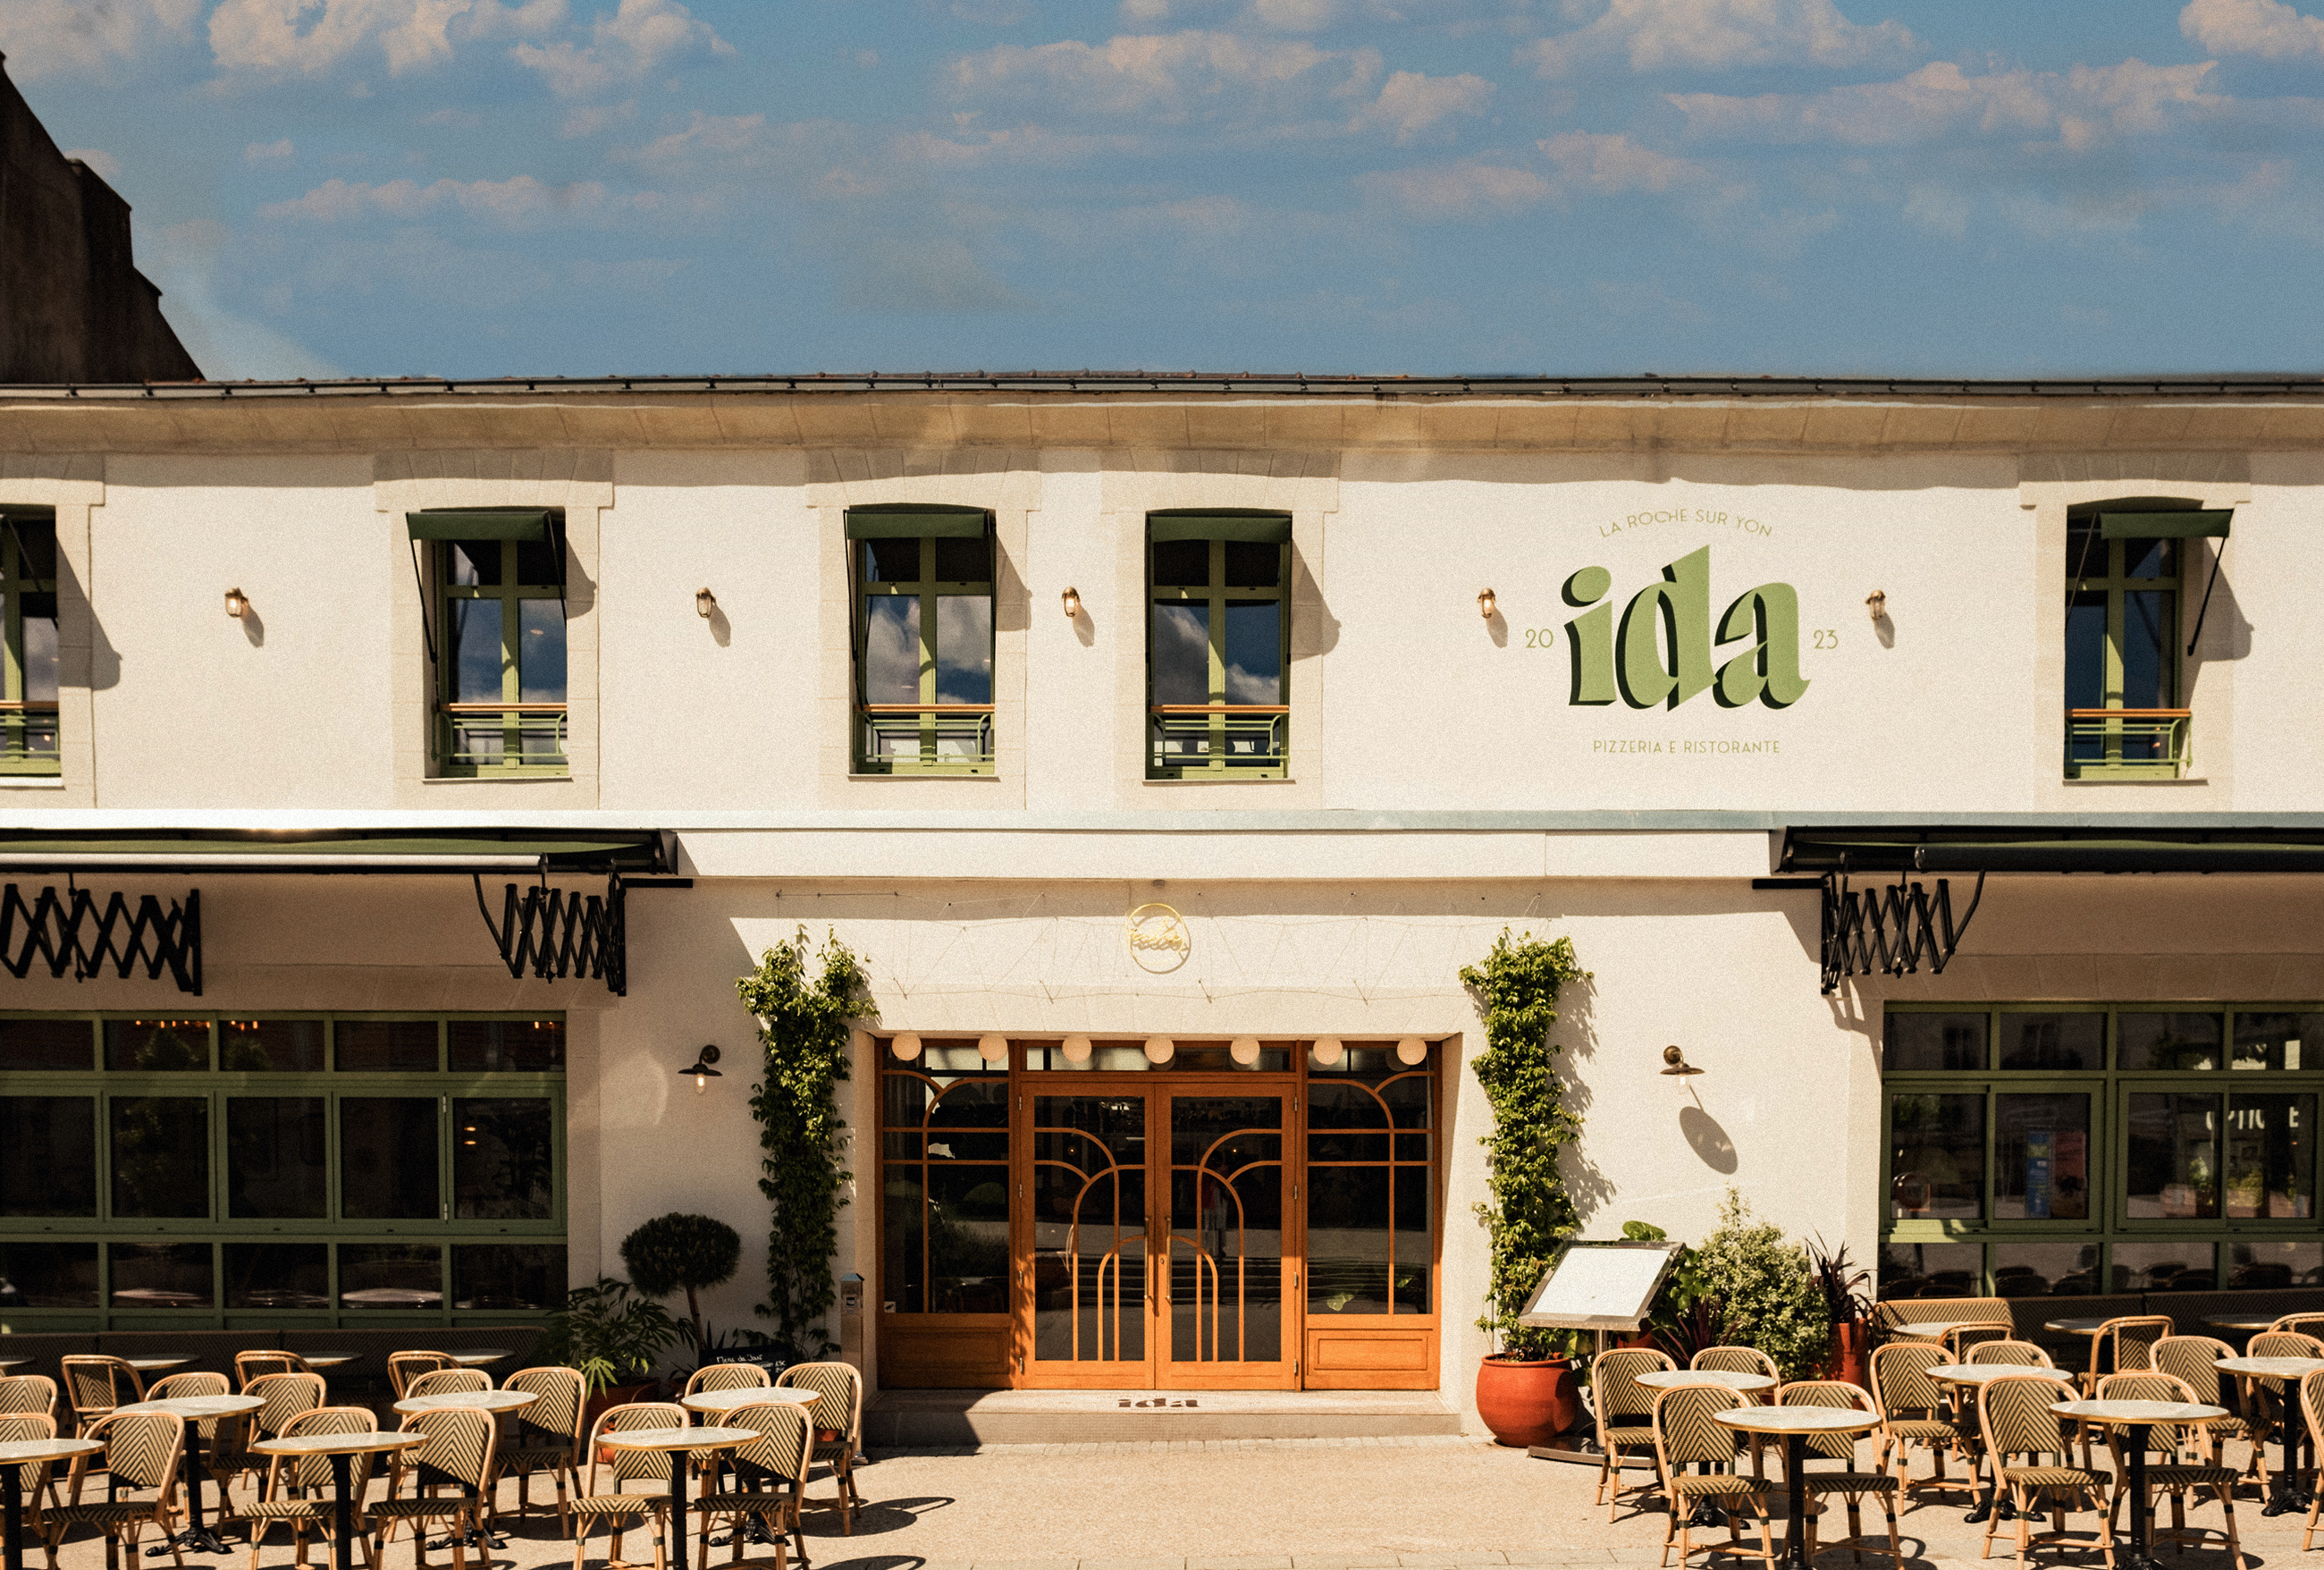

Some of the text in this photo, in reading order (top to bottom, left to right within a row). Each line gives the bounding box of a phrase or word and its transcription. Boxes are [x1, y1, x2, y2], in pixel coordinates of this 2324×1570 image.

[1599, 509, 1772, 537] LA ROCHE SUR YON
[1561, 544, 1812, 712] ida
[1525, 629, 1554, 648] 20
[1813, 629, 1839, 649] 23
[1593, 740, 1781, 754] PIZZERIA E RISTORANTE
[1117, 1397, 1200, 1408] ida
